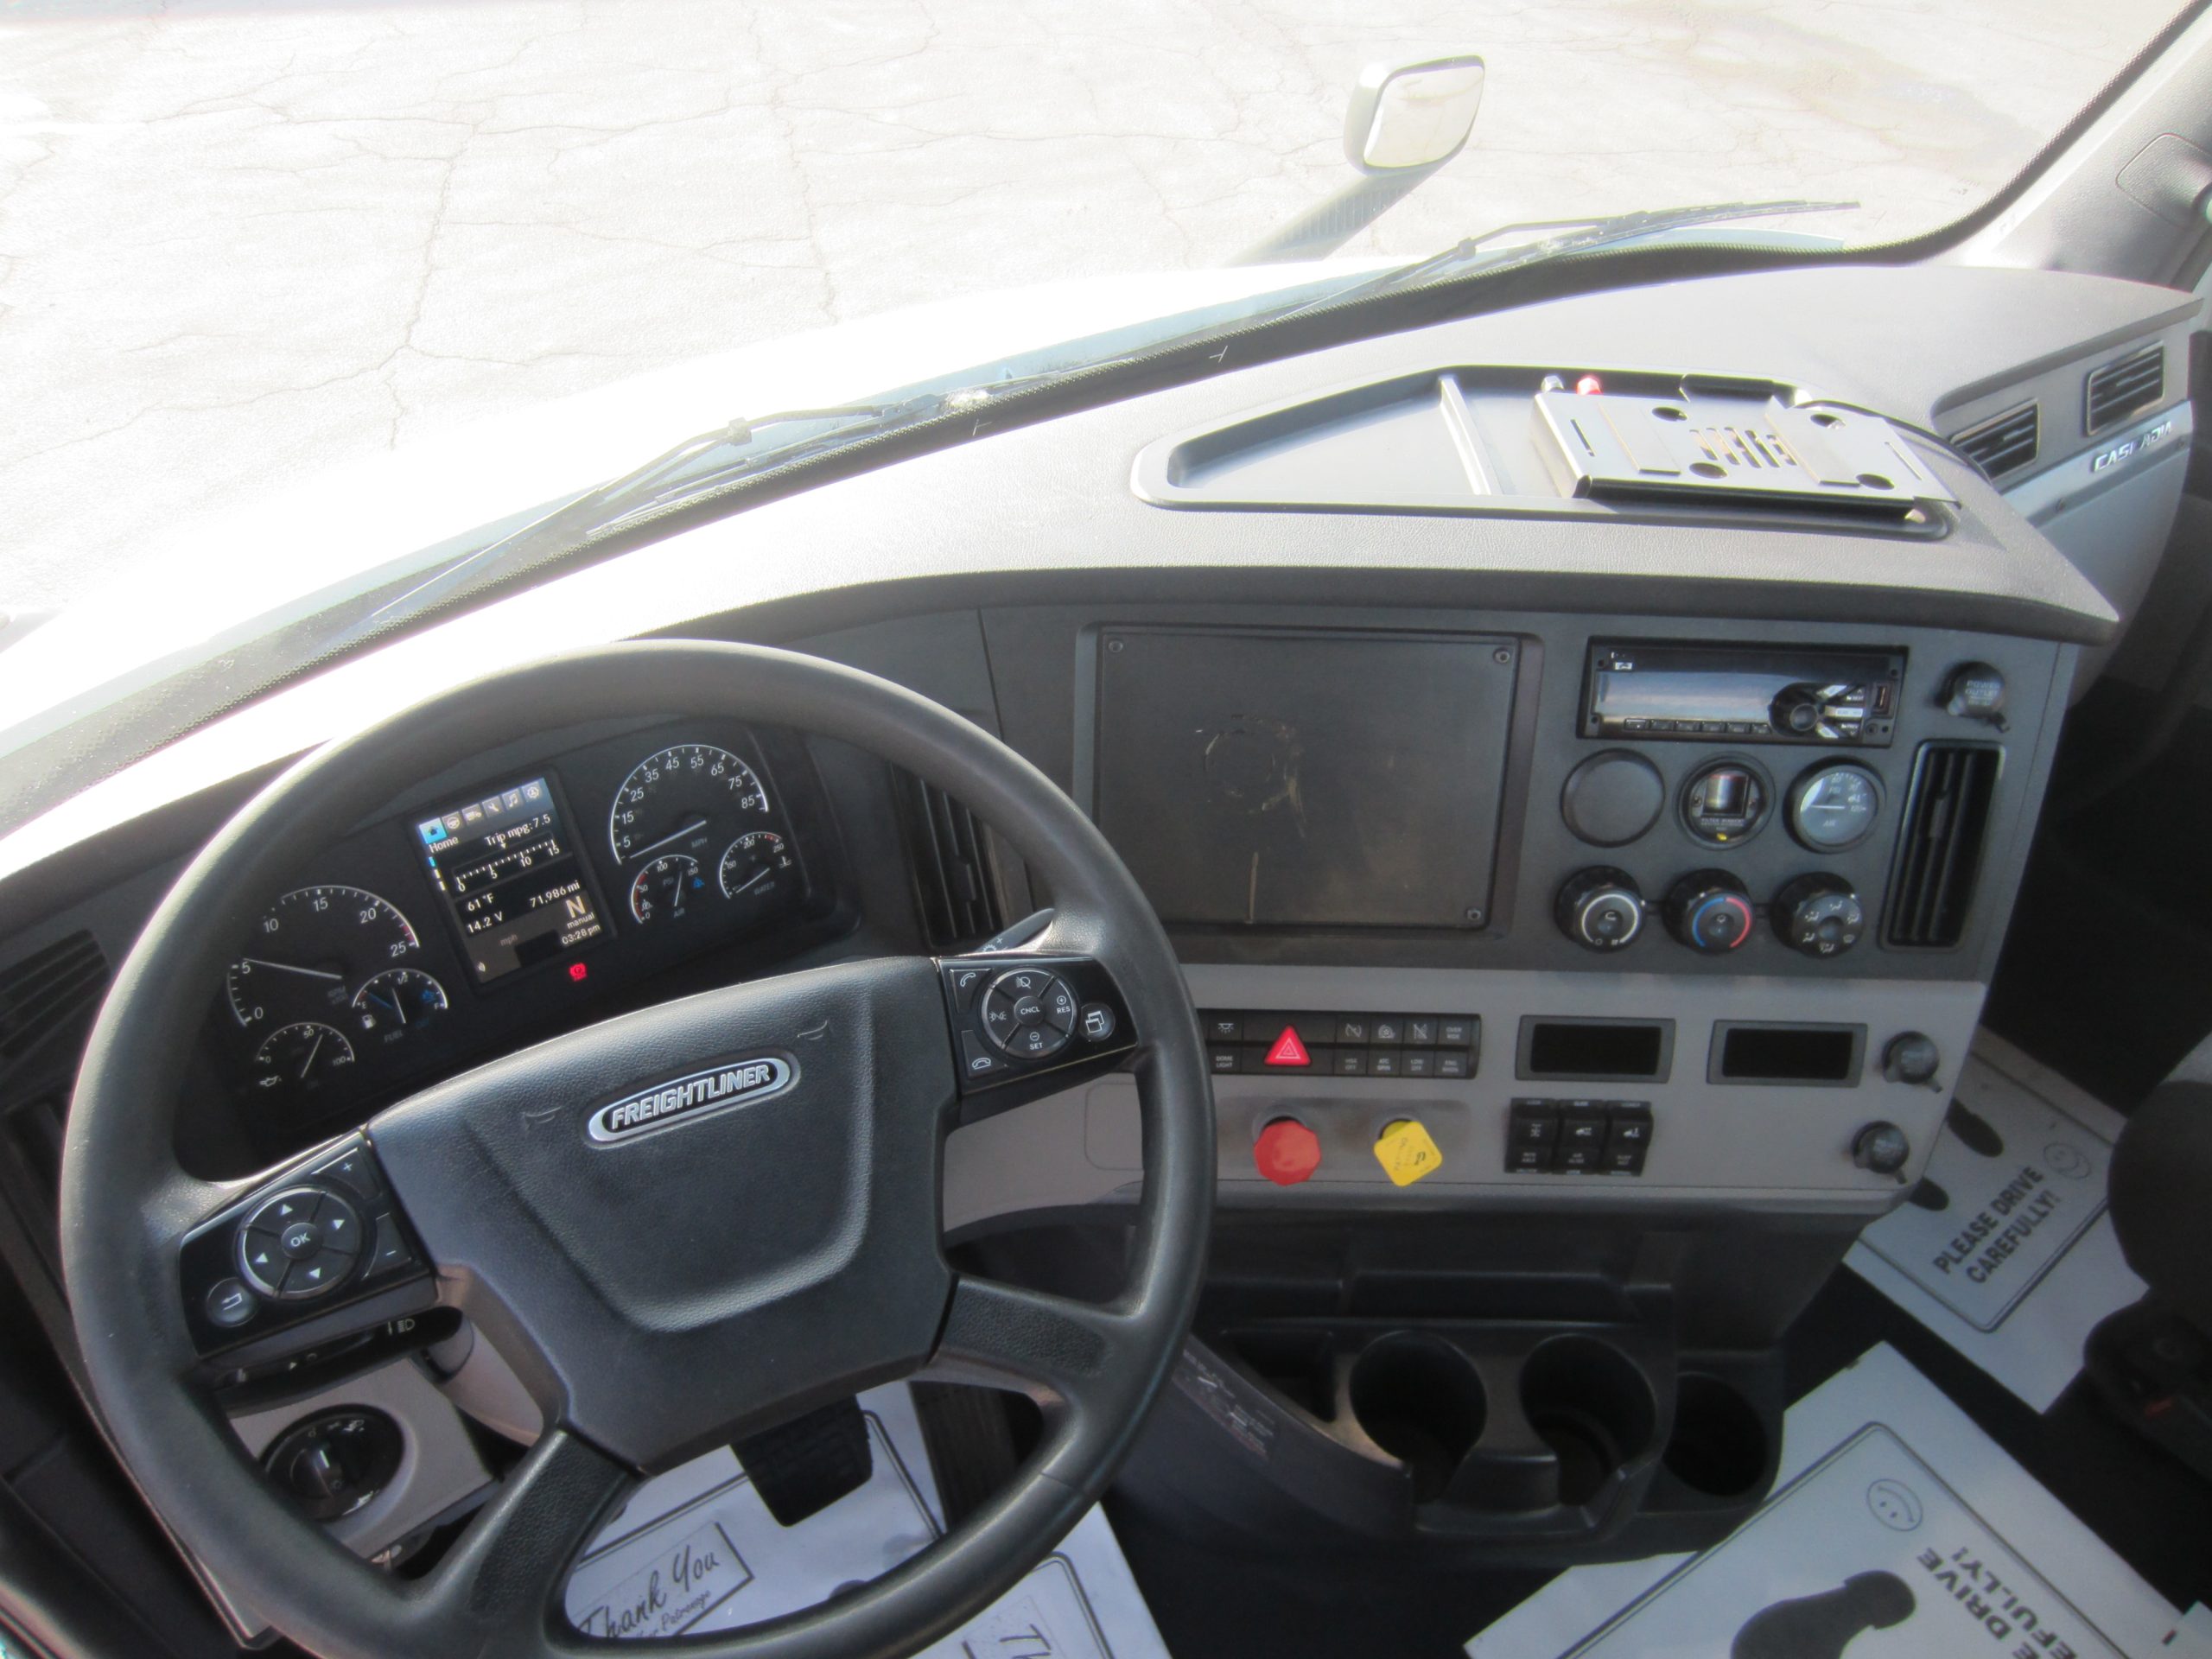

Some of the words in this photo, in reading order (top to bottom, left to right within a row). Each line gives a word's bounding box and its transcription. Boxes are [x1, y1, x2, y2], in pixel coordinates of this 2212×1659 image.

[665, 757, 679, 771] 45
[690, 755, 703, 769] 55
[645, 768, 659, 783] 35
[711, 763, 725, 776] 65
[728, 776, 742, 790] 75
[630, 787, 644, 802] 25
[741, 795, 754, 809] 85
[622, 811, 634, 824] 15
[485, 832, 505, 846] Trip
[533, 815, 550, 828] 7.5
[429, 836, 459, 854] Home
[623, 836, 631, 848] 5
[744, 839, 754, 849] 200
[773, 843, 784, 853] 250
[548, 846, 560, 856] 15
[520, 857, 531, 868] 10
[657, 862, 668, 872] 100
[491, 869, 498, 880] 5
[458, 881, 465, 892] 0
[568, 880, 580, 892] mi
[639, 884, 648, 893] 50
[314, 897, 328, 912] 15
[566, 895, 586, 918] N
[359, 908, 377, 924] 20
[467, 918, 492, 934] 14.2
[494, 912, 503, 922] V
[567, 912, 594, 929] manual
[264, 918, 279, 933] 10
[499, 933, 518, 946] mph
[562, 928, 588, 945] 03:28
[588, 924, 601, 938] pm
[391, 942, 407, 957] 25
[242, 962, 251, 973] 5
[254, 1007, 264, 1019] 0
[1057, 1006, 1071, 1014] RES
[304, 1029, 314, 1038] 50
[333, 1056, 346, 1066] 100
[612, 1065, 770, 1129] FREIGHTLINER
[1932, 1211, 1999, 1274] PLEASE
[1990, 1166, 2044, 1216] DRIVE
[290, 1233, 311, 1248] OK
[1967, 1189, 2061, 1283] CAREFULLY!
[578, 1570, 666, 1637] Thank
[672, 1544, 720, 1592] You
[1916, 1548, 2012, 1640] DRIVE
